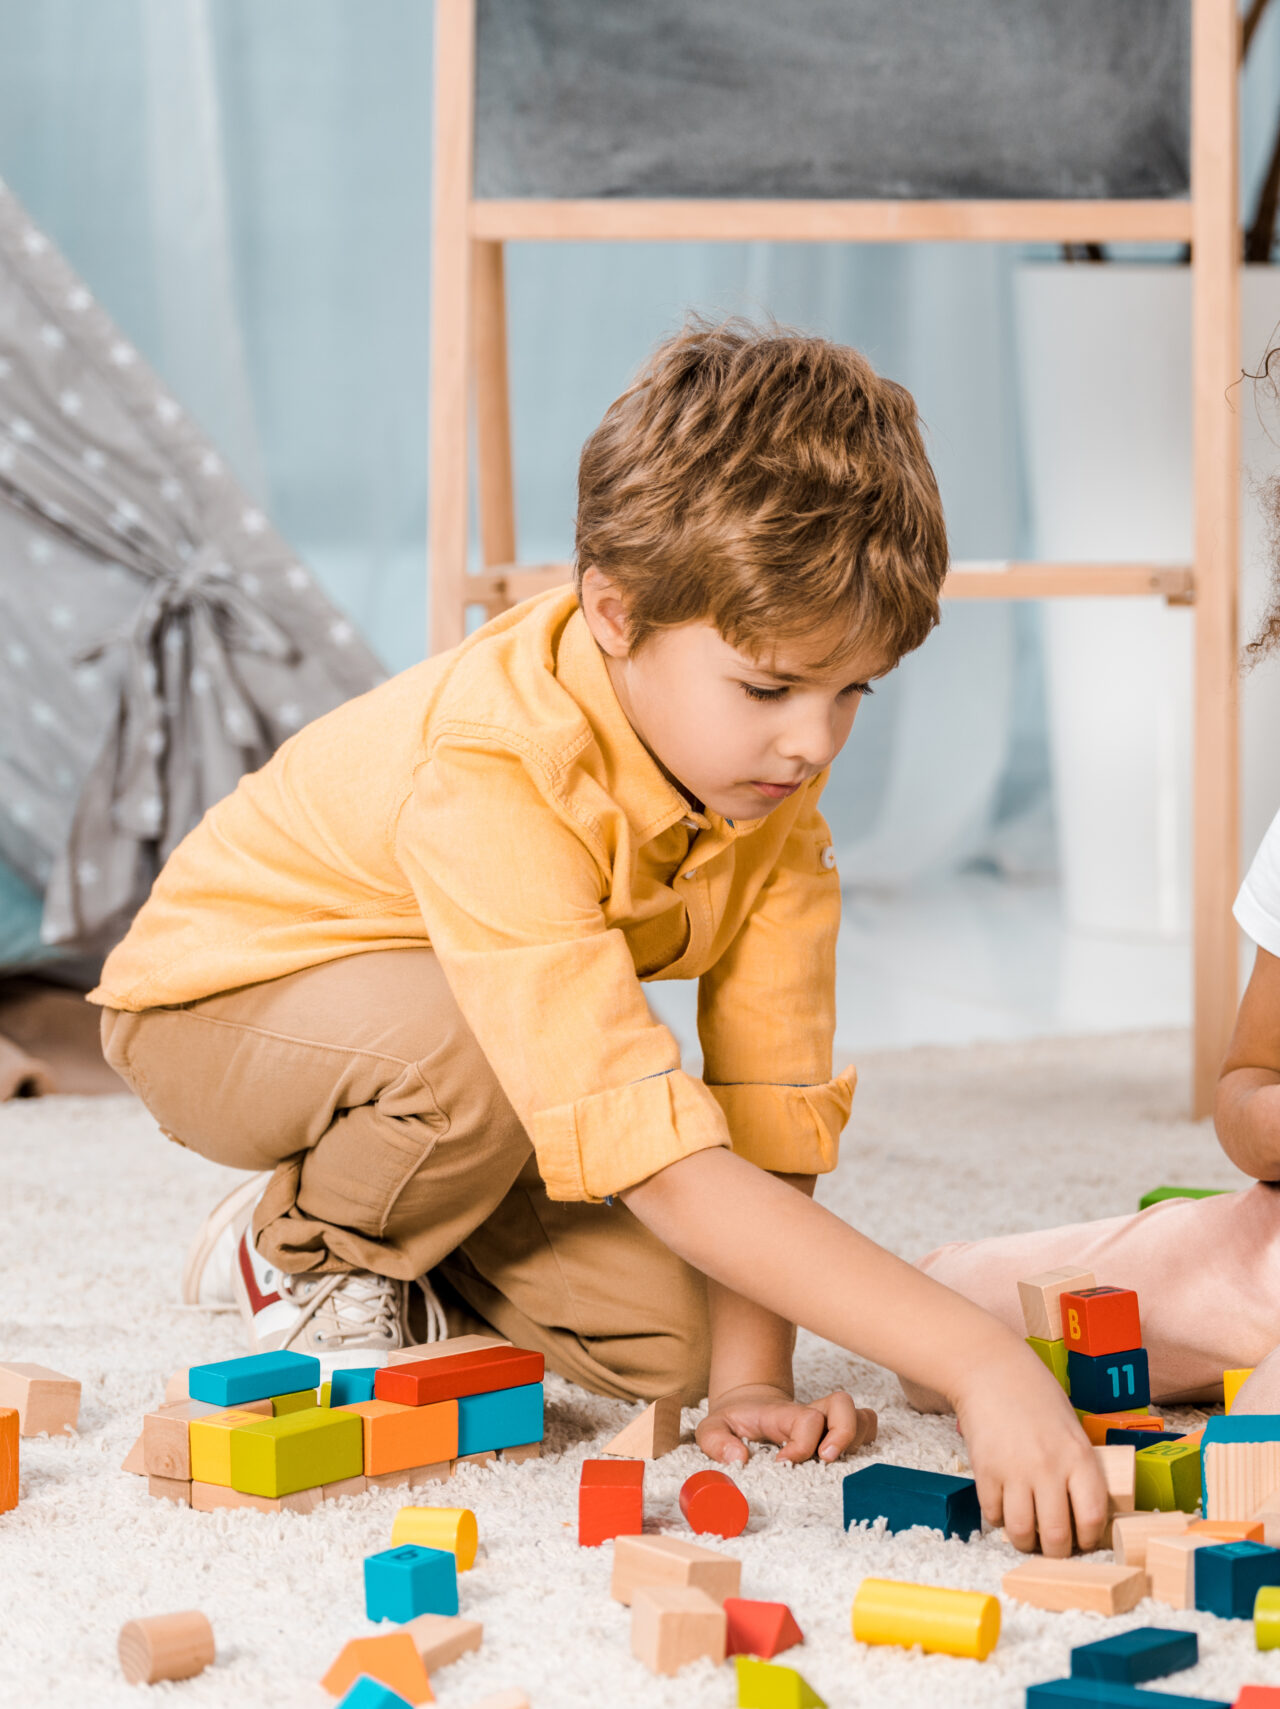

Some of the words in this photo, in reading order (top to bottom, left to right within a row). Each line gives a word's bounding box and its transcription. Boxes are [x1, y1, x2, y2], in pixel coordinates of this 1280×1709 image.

[1068, 1308, 1081, 1340] B
[1106, 1363, 1135, 1398] 11
[1141, 1445, 1188, 1457] 20
